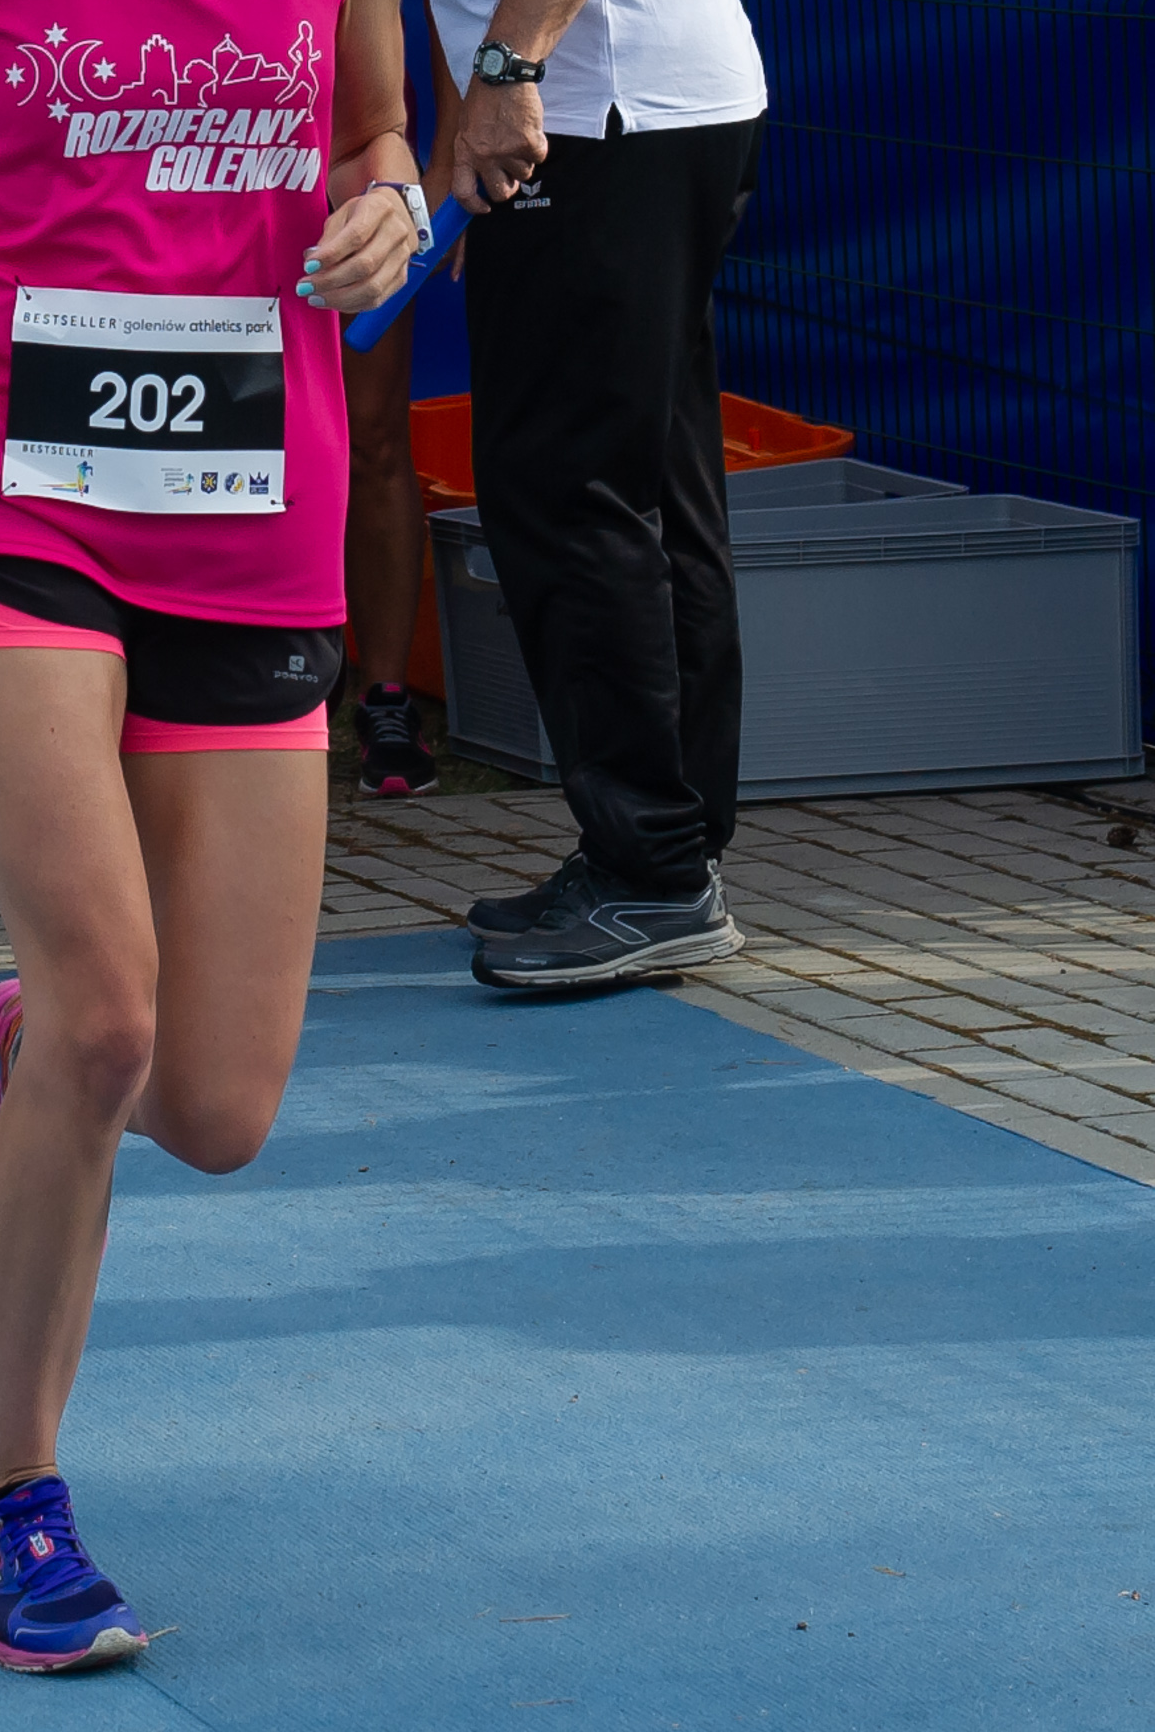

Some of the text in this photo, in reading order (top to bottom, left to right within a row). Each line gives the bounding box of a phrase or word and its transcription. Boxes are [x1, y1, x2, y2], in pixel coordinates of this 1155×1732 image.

[23, 311, 275, 336] BESTSELLER goleniów athletics park
[89, 371, 207, 433] 202
[22, 443, 95, 458] BESTSELLER
